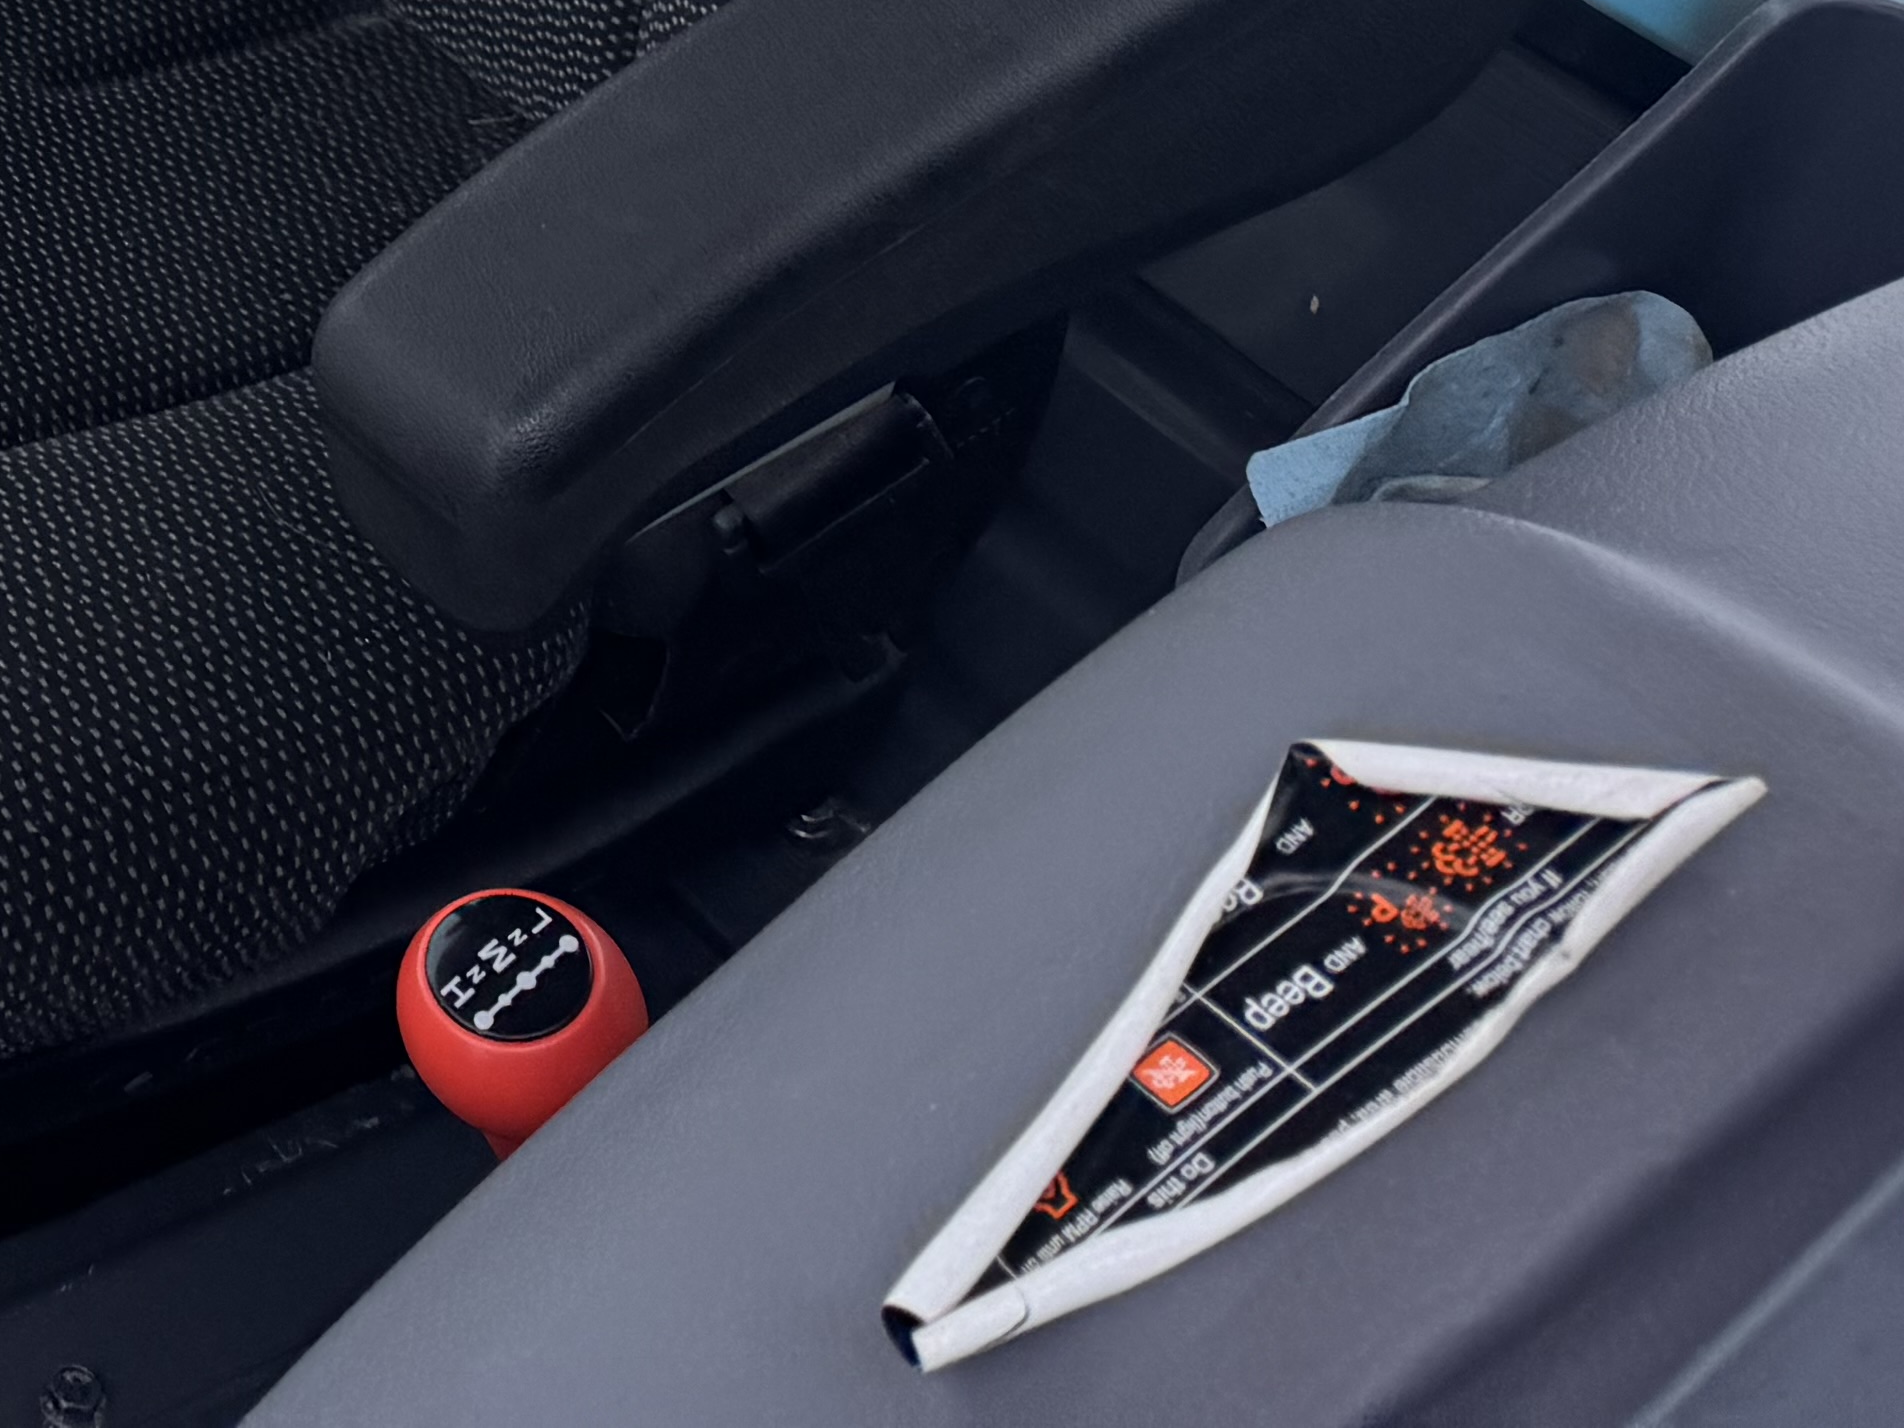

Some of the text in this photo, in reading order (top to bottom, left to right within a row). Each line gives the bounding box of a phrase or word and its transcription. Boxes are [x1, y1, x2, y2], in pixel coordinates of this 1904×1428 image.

[1276, 818, 1315, 855] AND
[1510, 876, 1547, 906] you
[1541, 867, 1563, 890] If
[440, 975, 476, 1009] H
[477, 938, 517, 974] M
[531, 906, 553, 935] L
[1244, 936, 1367, 1030] AND Beep
[1234, 1060, 1273, 1093] Push
[1091, 1178, 1133, 1215] Raise
[1146, 1151, 1216, 1209] Do this
[1060, 1205, 1099, 1243] RPM
